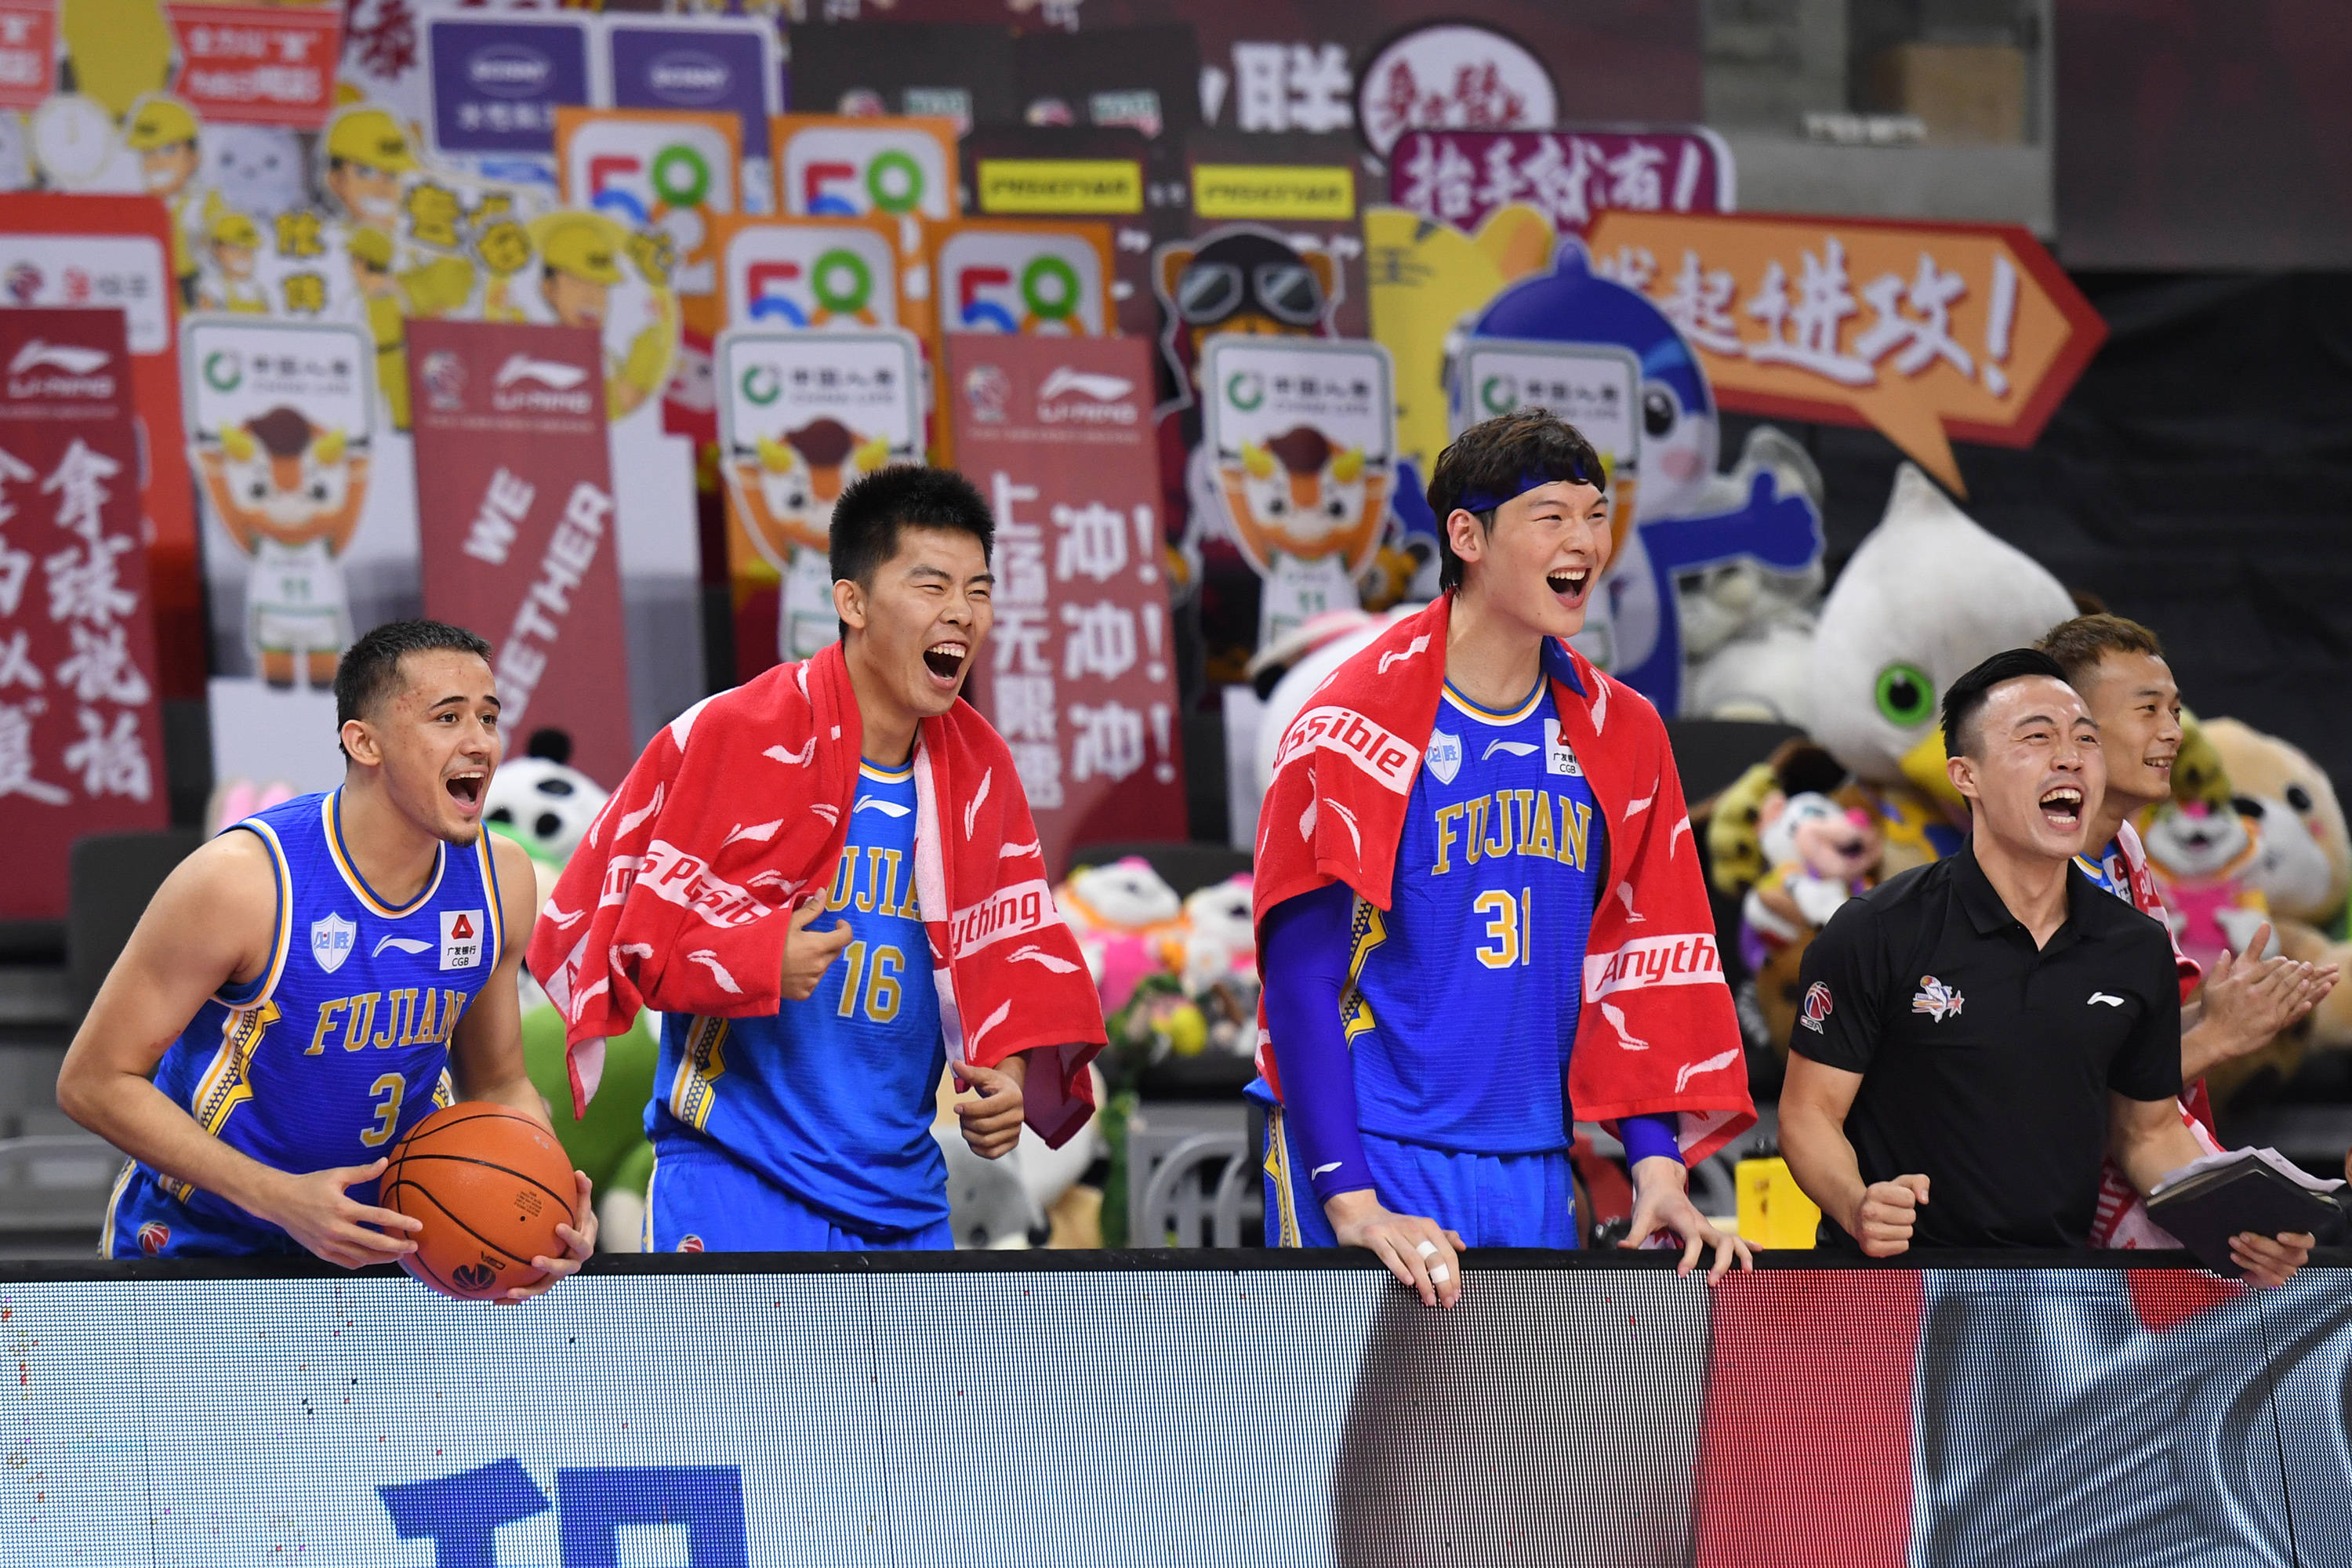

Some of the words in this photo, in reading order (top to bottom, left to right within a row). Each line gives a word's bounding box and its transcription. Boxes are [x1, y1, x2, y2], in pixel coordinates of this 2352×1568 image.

[494, 481, 614, 759] GETHER
[1559, 763, 1577, 775] CGB
[1430, 788, 1592, 877] FUJIAN
[447, 945, 477, 956] 广发银行
[949, 891, 1041, 953] ything
[1473, 887, 1530, 969] 31
[452, 956, 470, 967] CGB
[837, 940, 906, 1024] 16
[303, 987, 467, 1055] FUJIAN
[360, 1072, 407, 1149] 3
